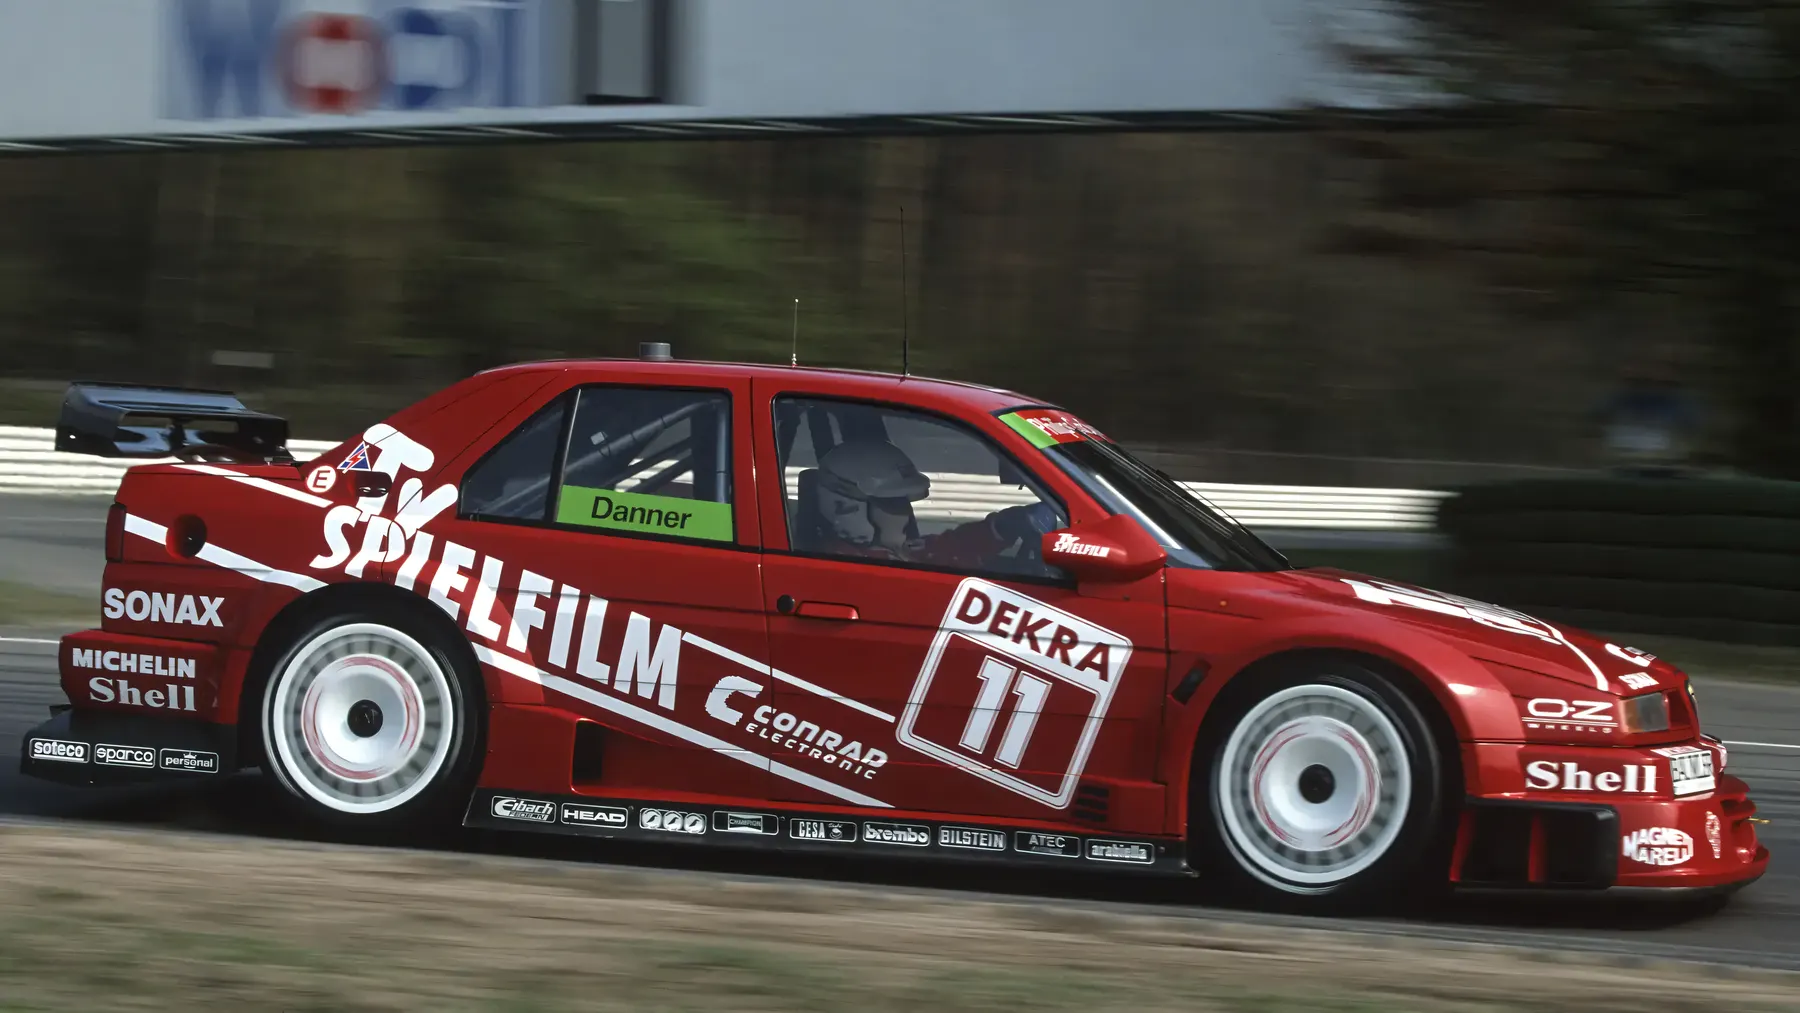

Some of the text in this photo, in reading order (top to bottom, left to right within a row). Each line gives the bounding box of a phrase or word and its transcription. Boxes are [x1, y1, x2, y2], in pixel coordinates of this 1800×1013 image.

[355, 423, 458, 539] TV
[591, 496, 692, 529] Danner
[104, 588, 225, 627] SONAX
[309, 505, 682, 711] SPIELFILM
[955, 587, 1110, 682] DEKRA
[72, 647, 196, 678] MICHELIN
[89, 677, 197, 711] Shell
[958, 655, 1052, 769] 11
[34, 741, 84, 758] soteco
[746, 722, 876, 779] ELECTRONIC
[753, 704, 888, 769] CONRAD
[97, 747, 153, 763] sparco
[166, 756, 213, 768] personal
[1526, 760, 1658, 793] Shell
[495, 799, 553, 817] Eibach
[564, 809, 625, 823] HEAD
[799, 821, 826, 839] CESA
[866, 824, 928, 843] brembo
[940, 829, 1003, 848] BILSTEIN
[1028, 834, 1066, 848] ATEC
